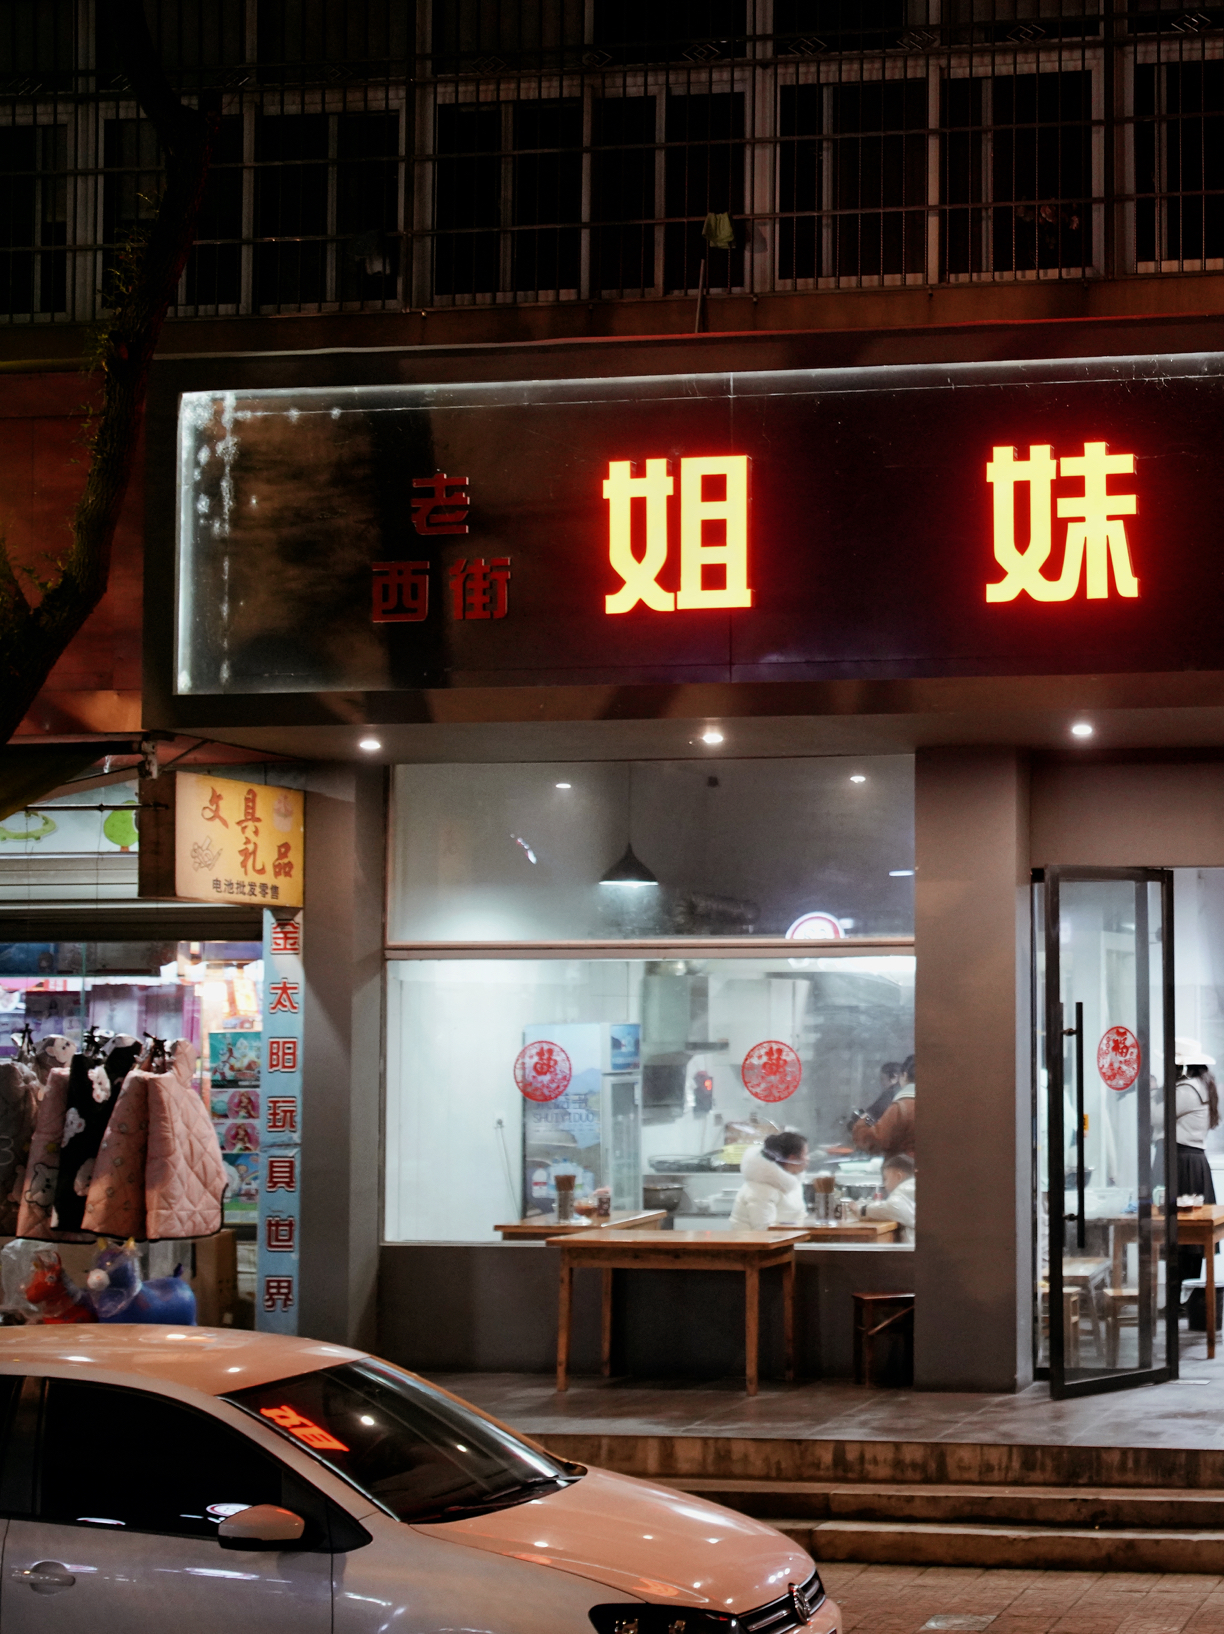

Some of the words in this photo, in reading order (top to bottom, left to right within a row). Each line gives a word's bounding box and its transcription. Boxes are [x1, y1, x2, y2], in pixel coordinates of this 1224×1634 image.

[411, 472, 471, 536] 老
[371, 556, 513, 624] 西街
[201, 786, 263, 838] 文具
[238, 837, 295, 879] 礼品
[212, 877, 280, 900] 电池批发零售
[263, 917, 301, 1313] 金太阳玩具世界
